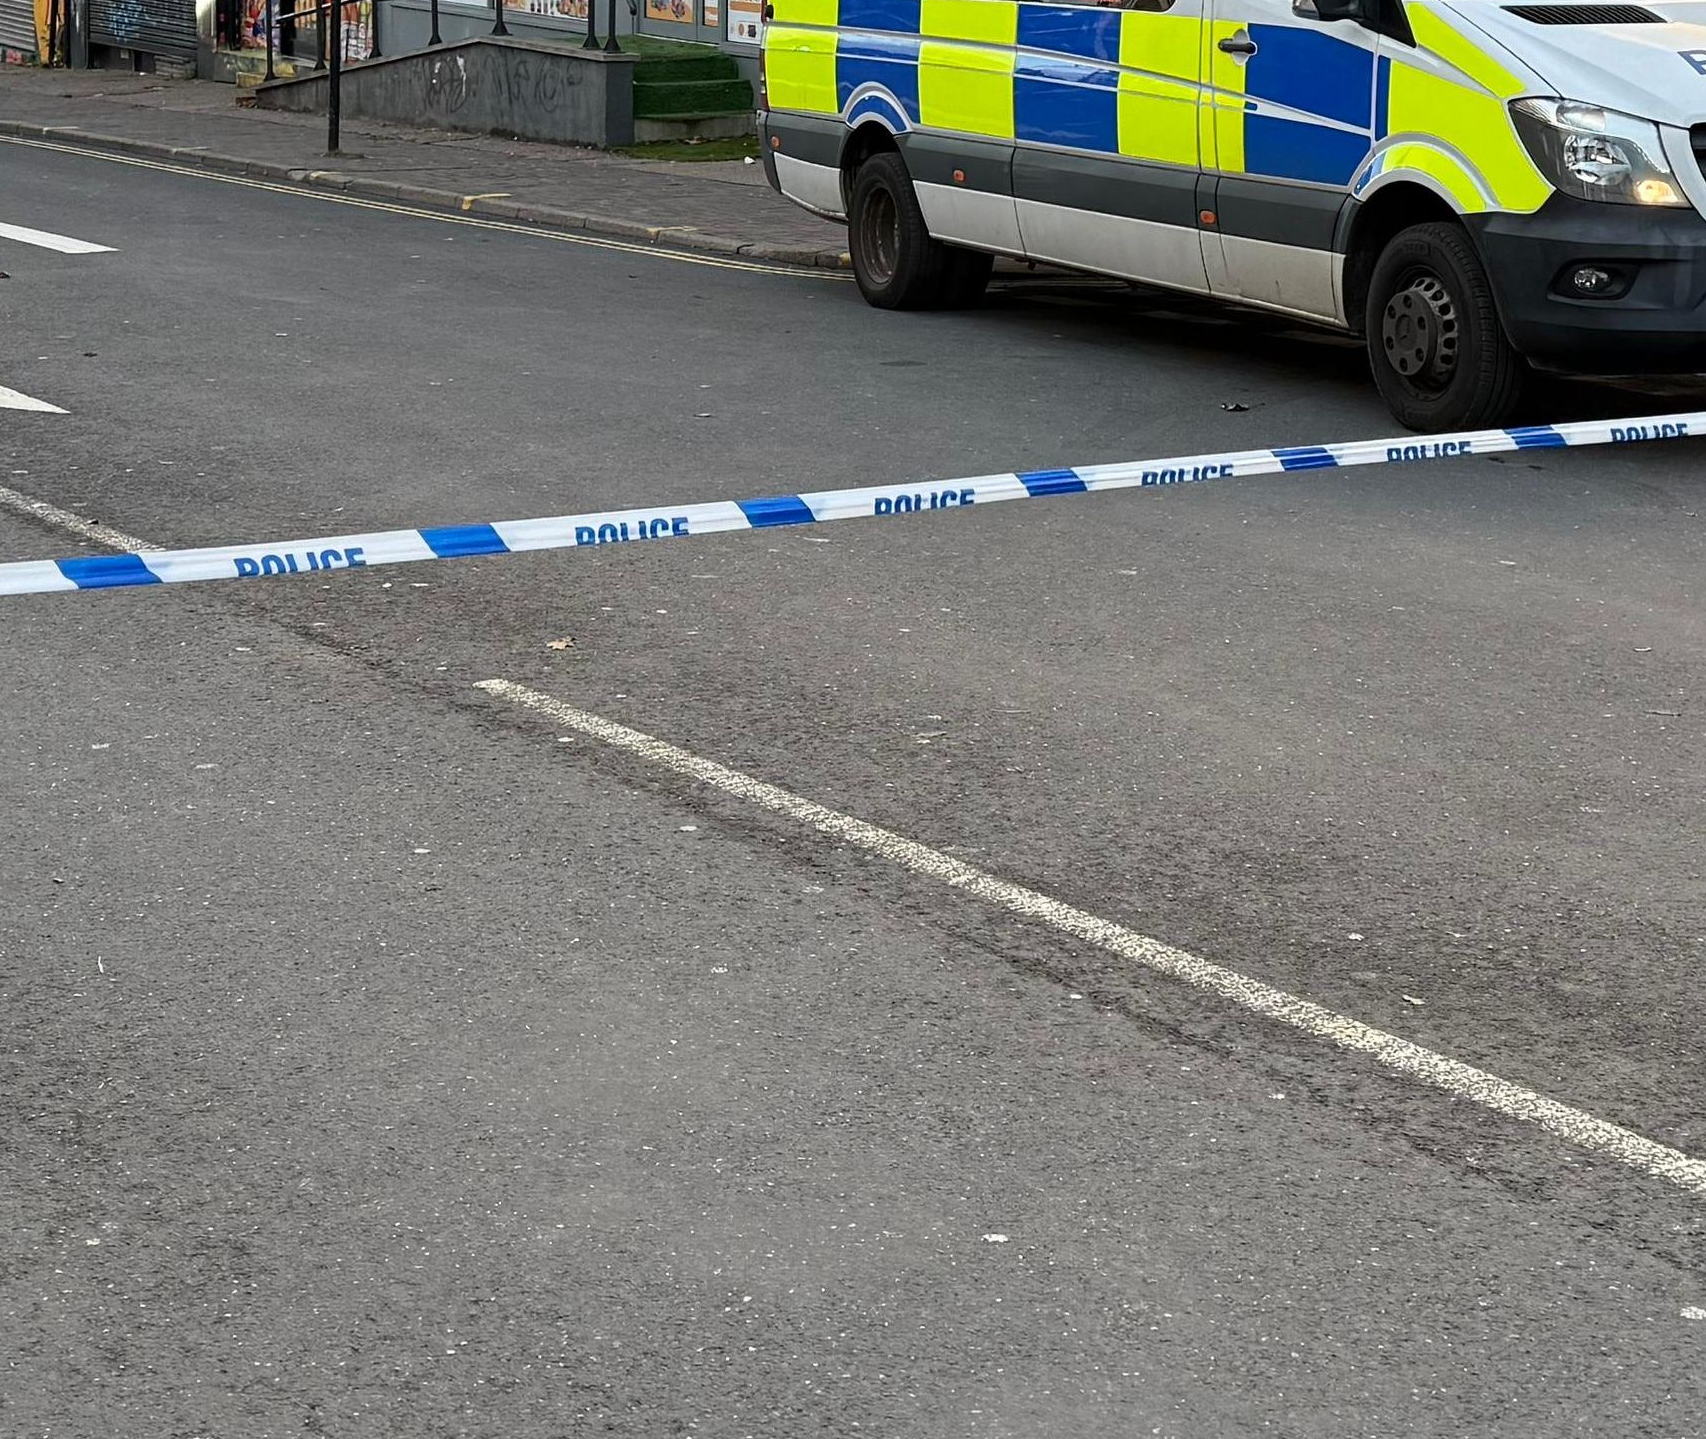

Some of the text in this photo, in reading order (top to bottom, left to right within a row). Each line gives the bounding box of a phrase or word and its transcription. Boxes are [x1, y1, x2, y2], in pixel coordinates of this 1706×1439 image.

[233, 547, 365, 577] POLICE
[573, 516, 690, 547] POLICE
[873, 488, 976, 516] POLICE
[1609, 422, 1689, 443] POLICE
